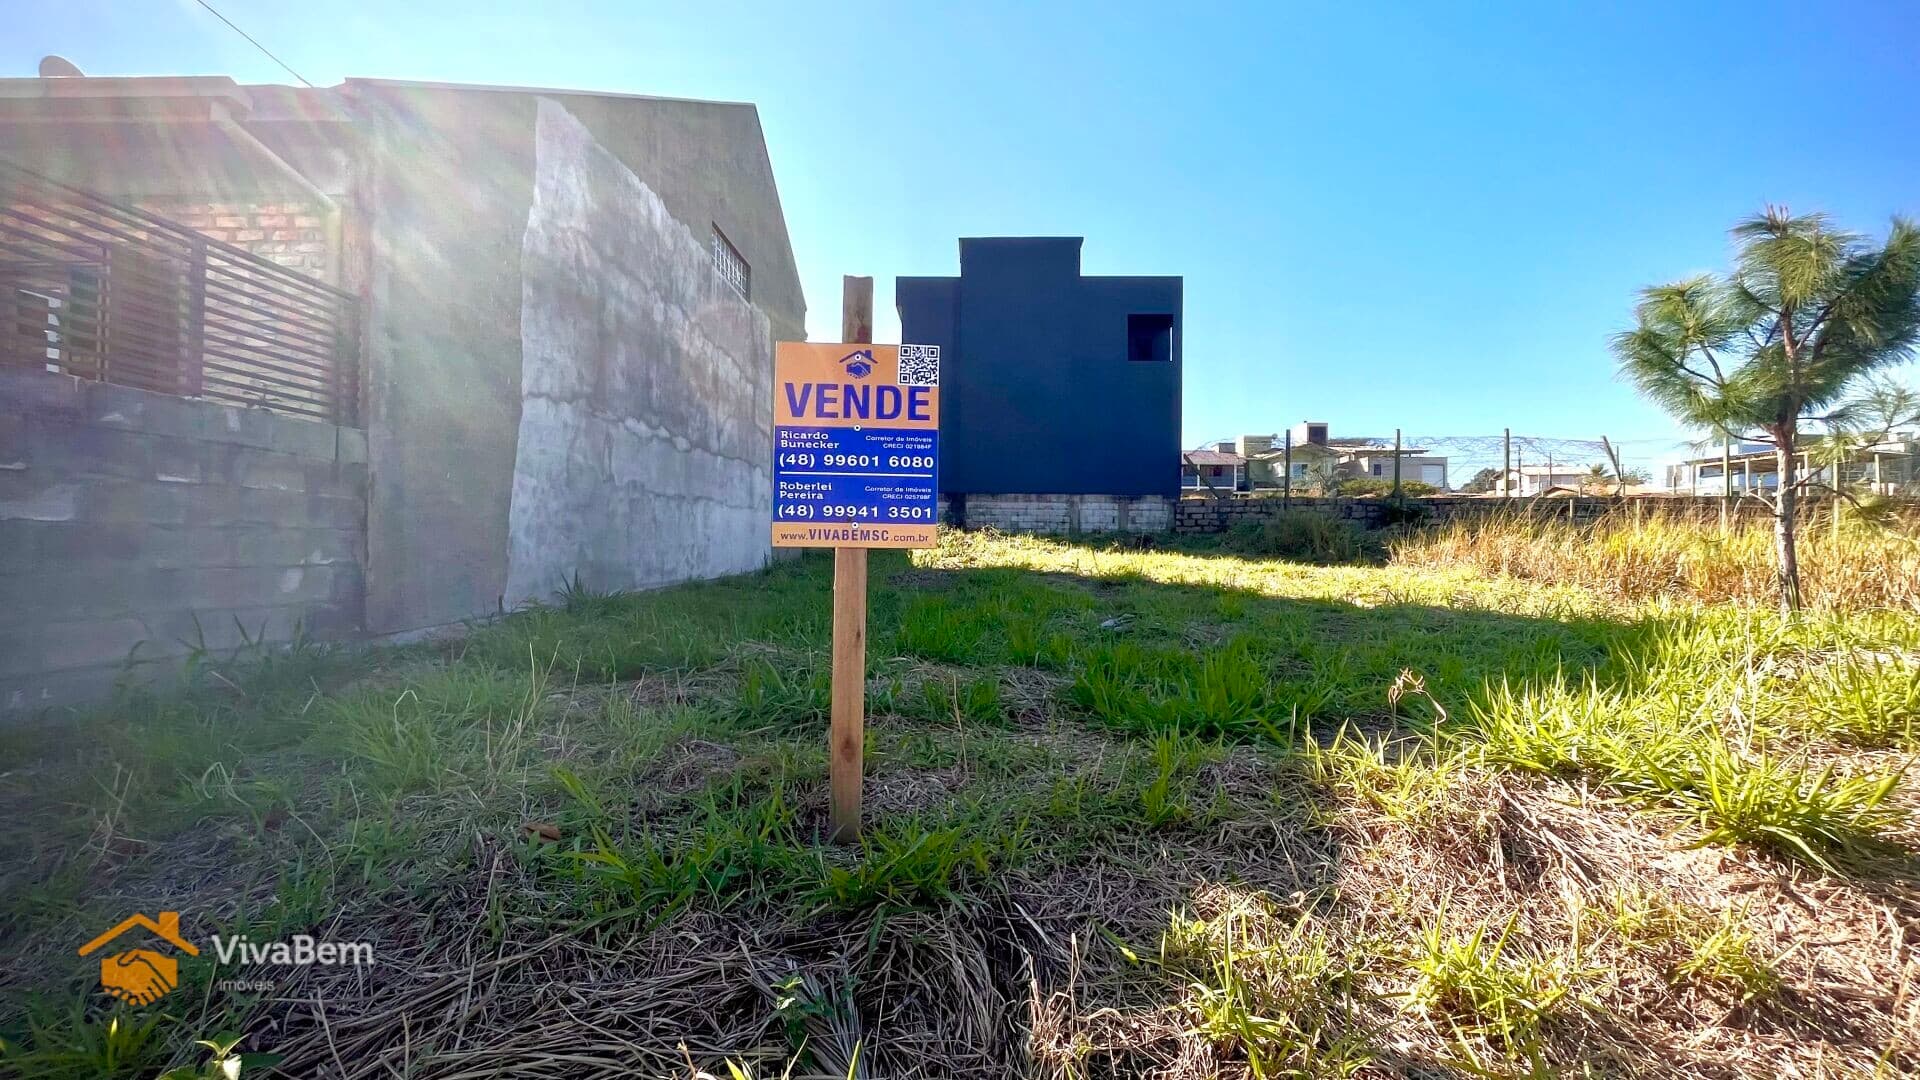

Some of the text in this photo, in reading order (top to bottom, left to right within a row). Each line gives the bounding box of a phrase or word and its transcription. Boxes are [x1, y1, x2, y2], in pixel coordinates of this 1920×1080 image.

[785, 383, 930, 420] VENDE
[781, 431, 829, 440] Ricardo
[781, 440, 840, 449] Bunecker
[779, 453, 934, 469] (48) 99601 6080
[779, 481, 832, 491] Roberlei
[779, 490, 824, 500] Pereira
[778, 504, 931, 519] (48) 99941 3501
[780, 528, 930, 543] www.VIVABEMSC.com.br
